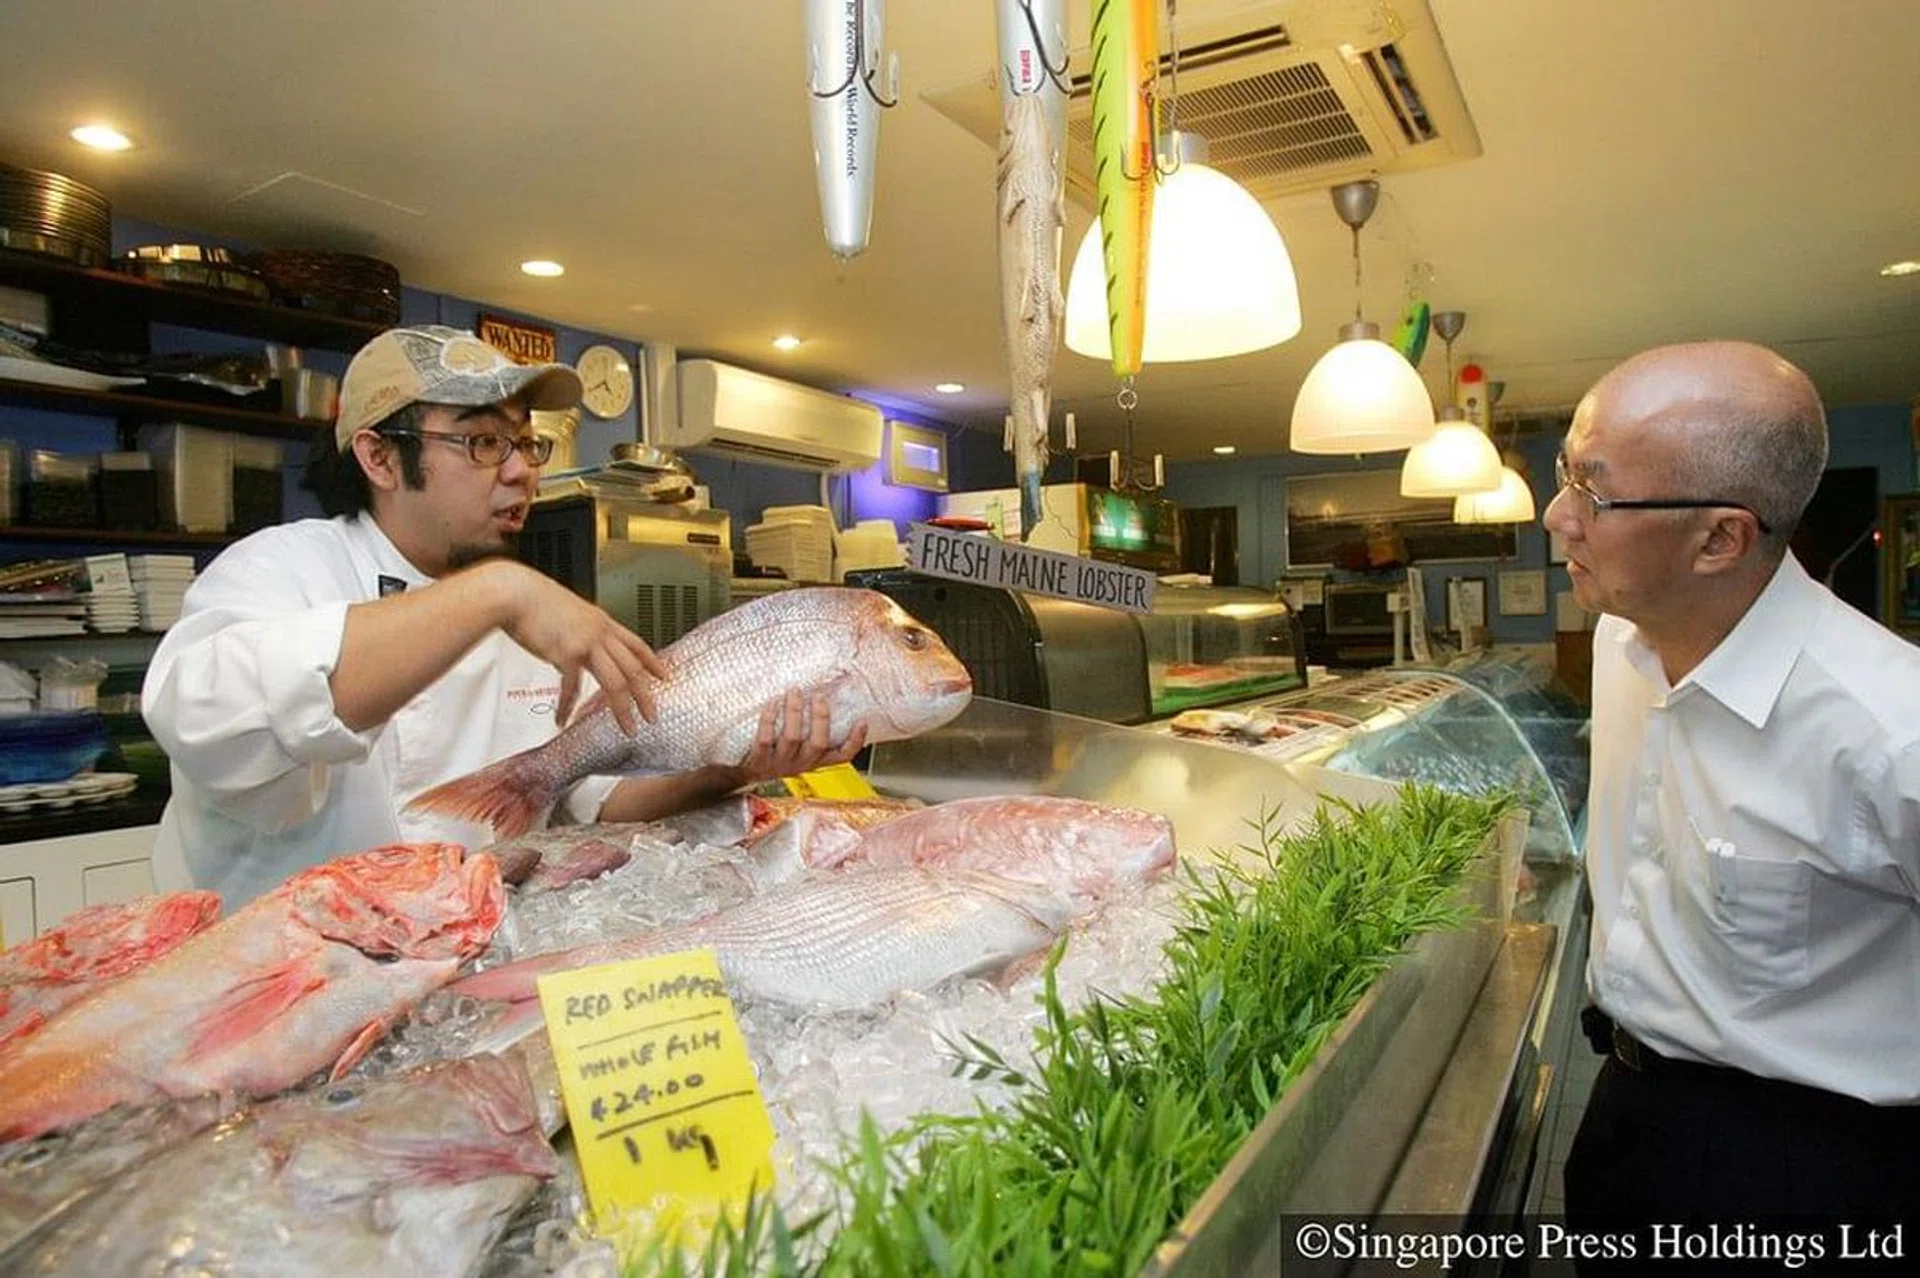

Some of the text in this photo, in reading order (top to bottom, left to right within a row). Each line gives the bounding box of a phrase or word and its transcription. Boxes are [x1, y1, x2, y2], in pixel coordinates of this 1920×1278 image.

[846, 87, 858, 126] World
[484, 325, 552, 361] WANTED
[921, 533, 1149, 609] FRESH MAINE LOBSTER
[565, 996, 611, 1025] RED
[666, 1030, 721, 1060] FISH
